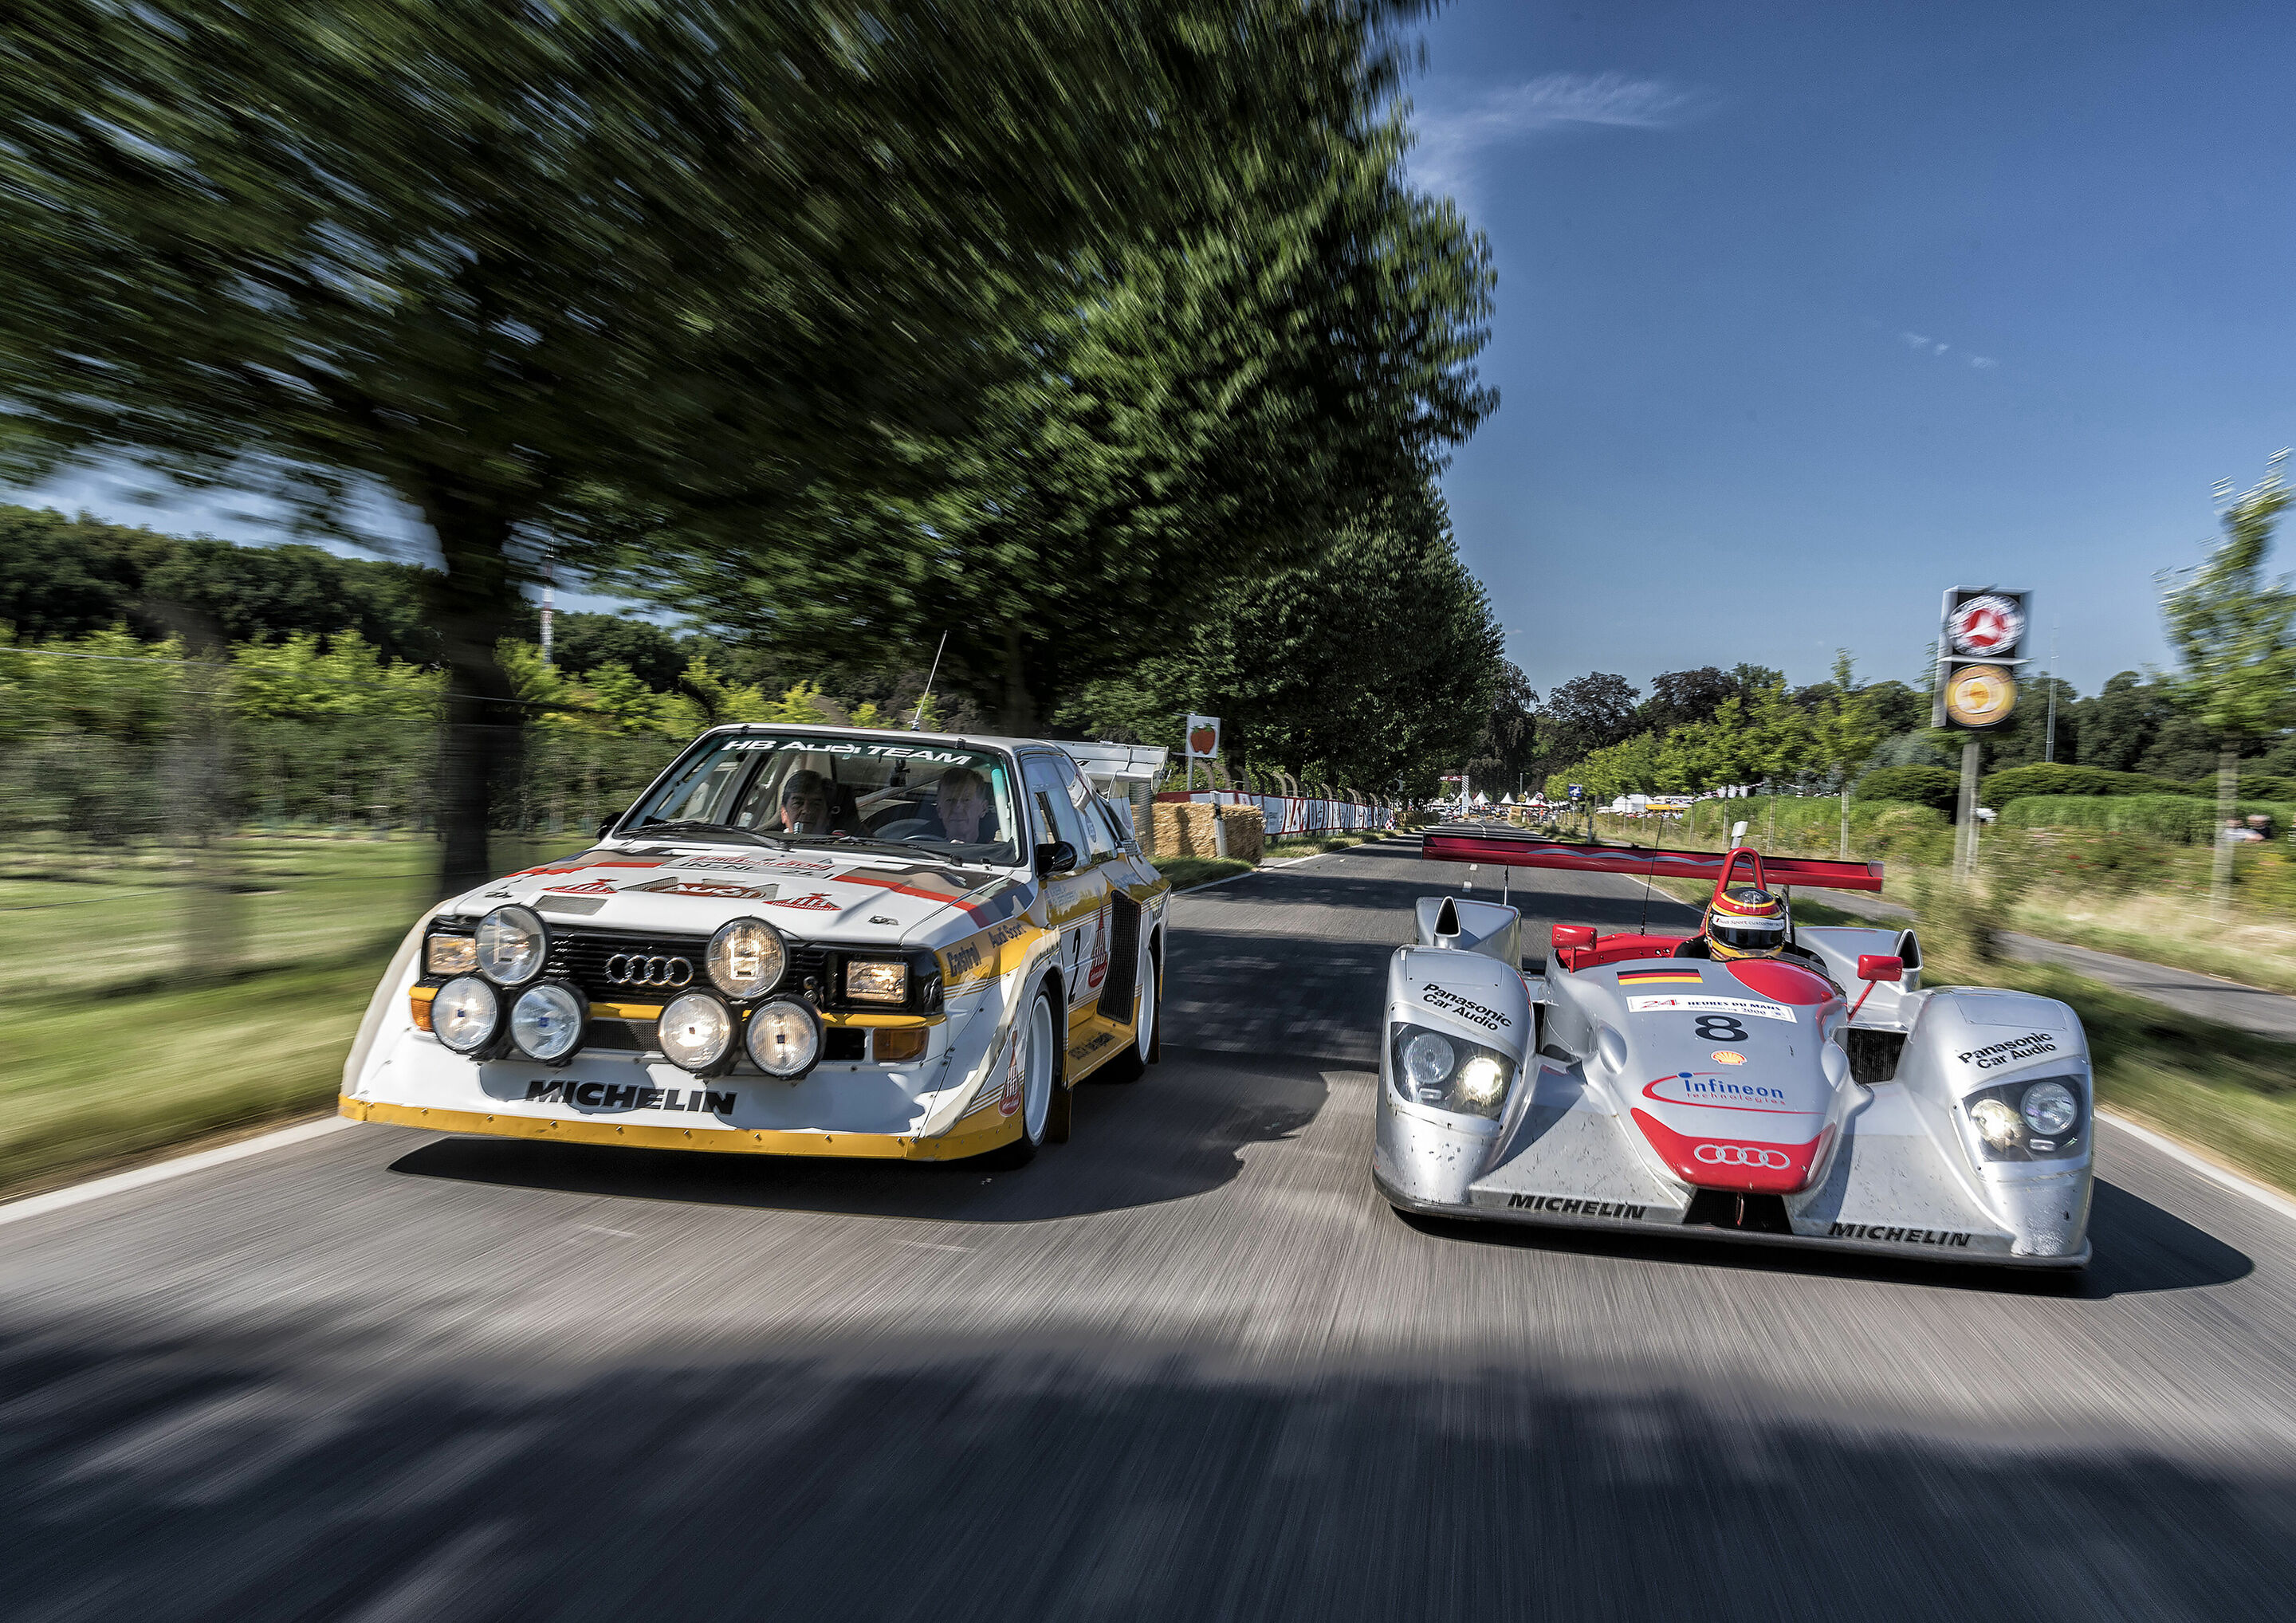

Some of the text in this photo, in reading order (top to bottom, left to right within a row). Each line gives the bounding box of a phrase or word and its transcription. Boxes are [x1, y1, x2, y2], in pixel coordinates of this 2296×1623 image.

[721, 739, 777, 751] HB
[866, 745, 973, 765] TEAM
[946, 941, 982, 977] Castrol
[1067, 928, 1081, 1004] 2
[1422, 983, 1512, 1027] Panasonic
[1422, 993, 1499, 1031] Car Audio
[1641, 999, 1677, 1009] 24
[1750, 1003, 1781, 1012] MANS
[1741, 1007, 1767, 1016] 2000
[1694, 1015, 1749, 1042] 8
[1958, 1032, 2054, 1064] Panasonic
[1977, 1043, 2057, 1069] Car Audio
[524, 1079, 738, 1116] MICHELIN
[1684, 1078, 1785, 1099] Infineon
[1686, 1092, 1787, 1106] technologies
[1507, 1193, 1648, 1220] MICHELIN
[1827, 1222, 1972, 1248] MICHELIN
